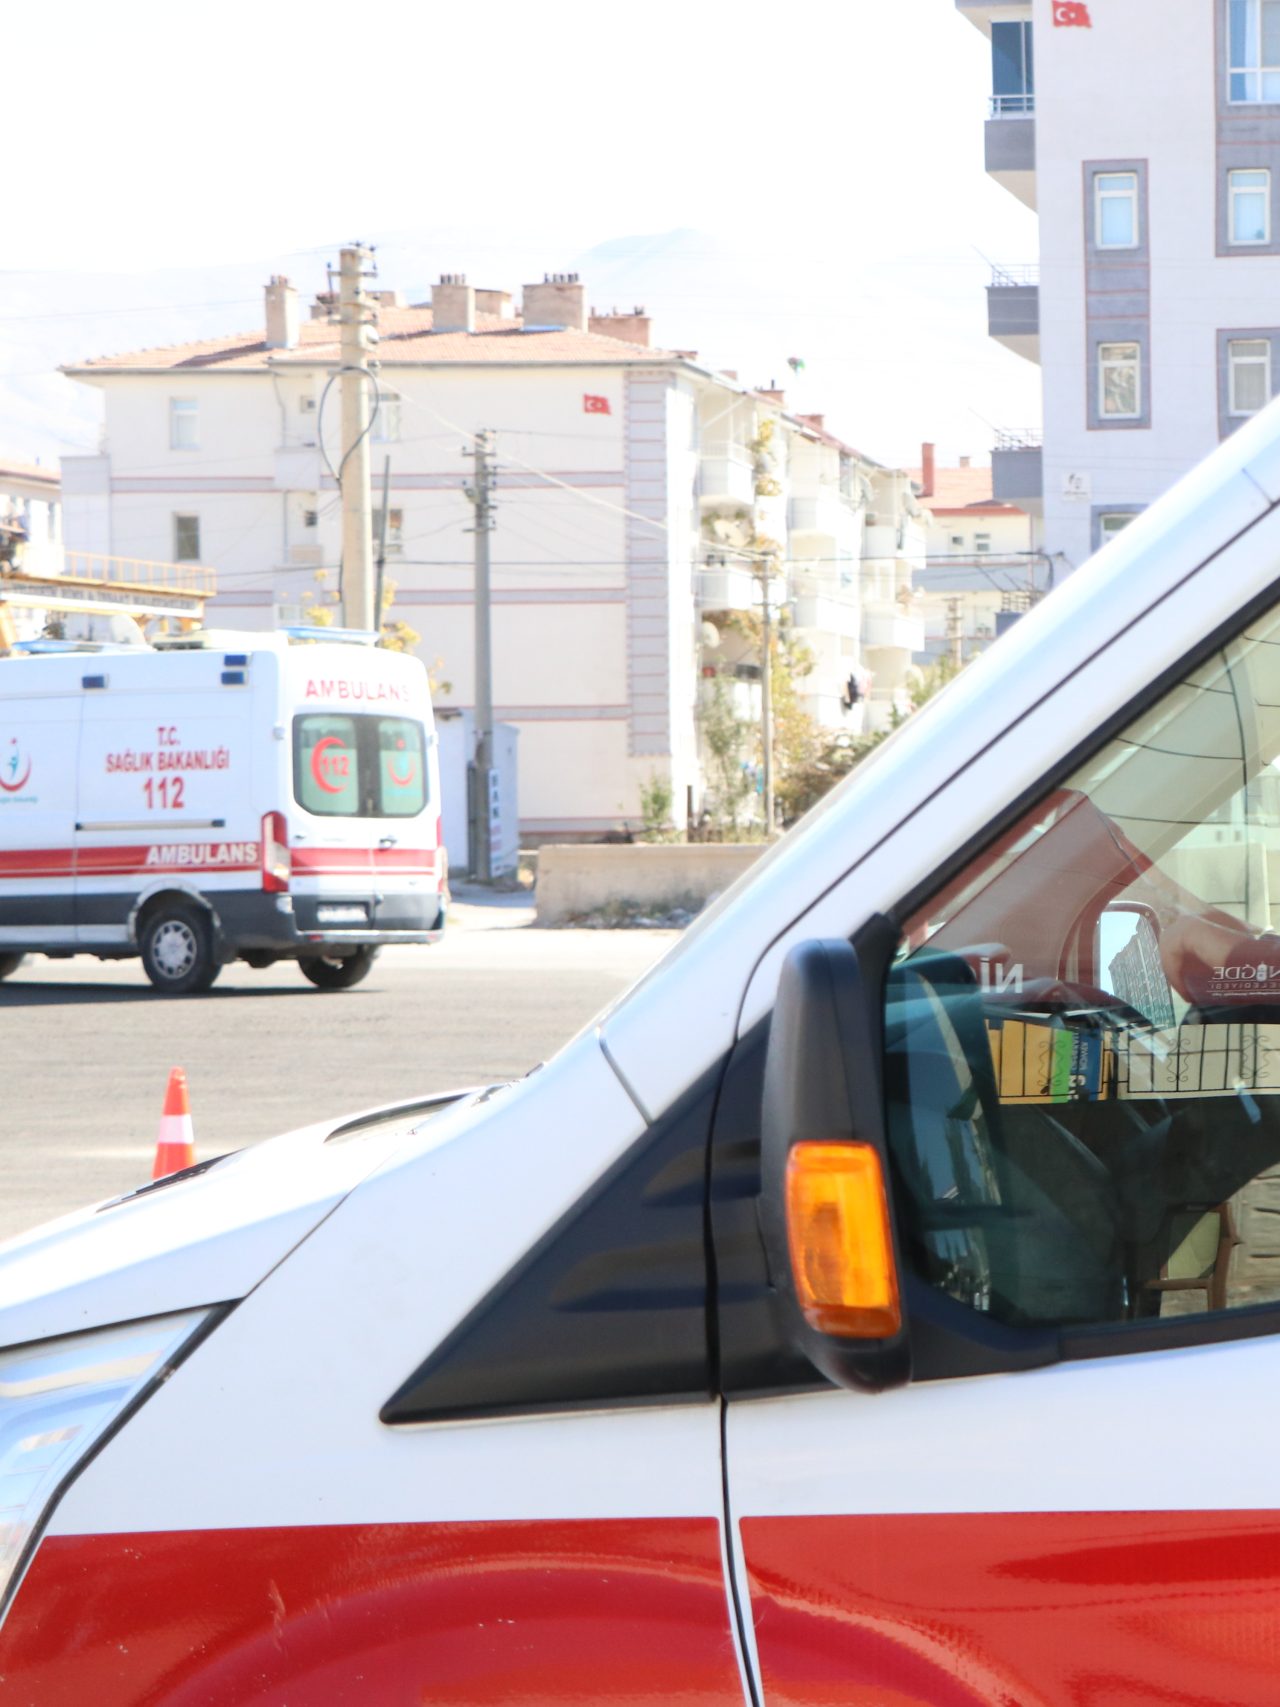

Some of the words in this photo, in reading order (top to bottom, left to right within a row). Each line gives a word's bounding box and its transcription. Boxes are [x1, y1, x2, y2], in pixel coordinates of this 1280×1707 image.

[305, 680, 410, 702] AMBULANS
[157, 726, 181, 746] T.C.
[106, 748, 153, 773] SAĞLIK
[157, 745, 230, 772] BAKANLIĞI
[322, 755, 349, 777] 112
[143, 776, 185, 809] 112
[146, 843, 258, 866] AMBULANS
